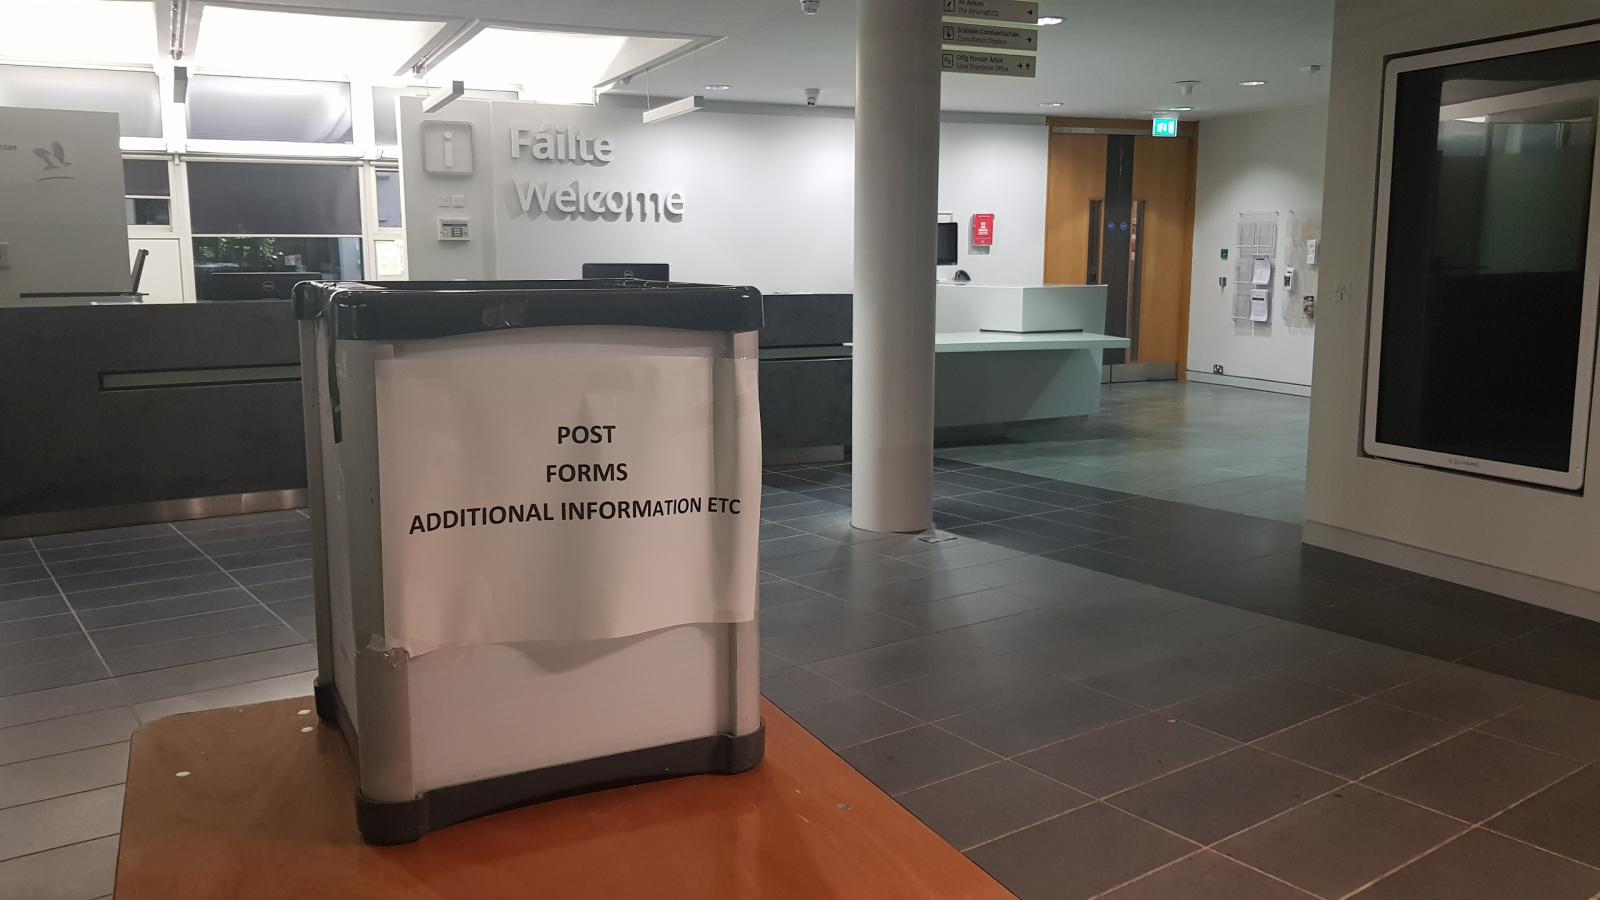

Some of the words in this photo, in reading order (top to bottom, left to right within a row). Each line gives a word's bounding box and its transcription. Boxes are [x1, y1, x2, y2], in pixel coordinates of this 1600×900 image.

[510, 123, 615, 163] Fáilte
[513, 179, 686, 217] Welcome
[557, 425, 617, 445] POST
[546, 463, 629, 483] FORMS
[409, 502, 554, 535] ADDITIONAL
[560, 497, 702, 521] INFORMATION
[707, 496, 742, 515] ETC
